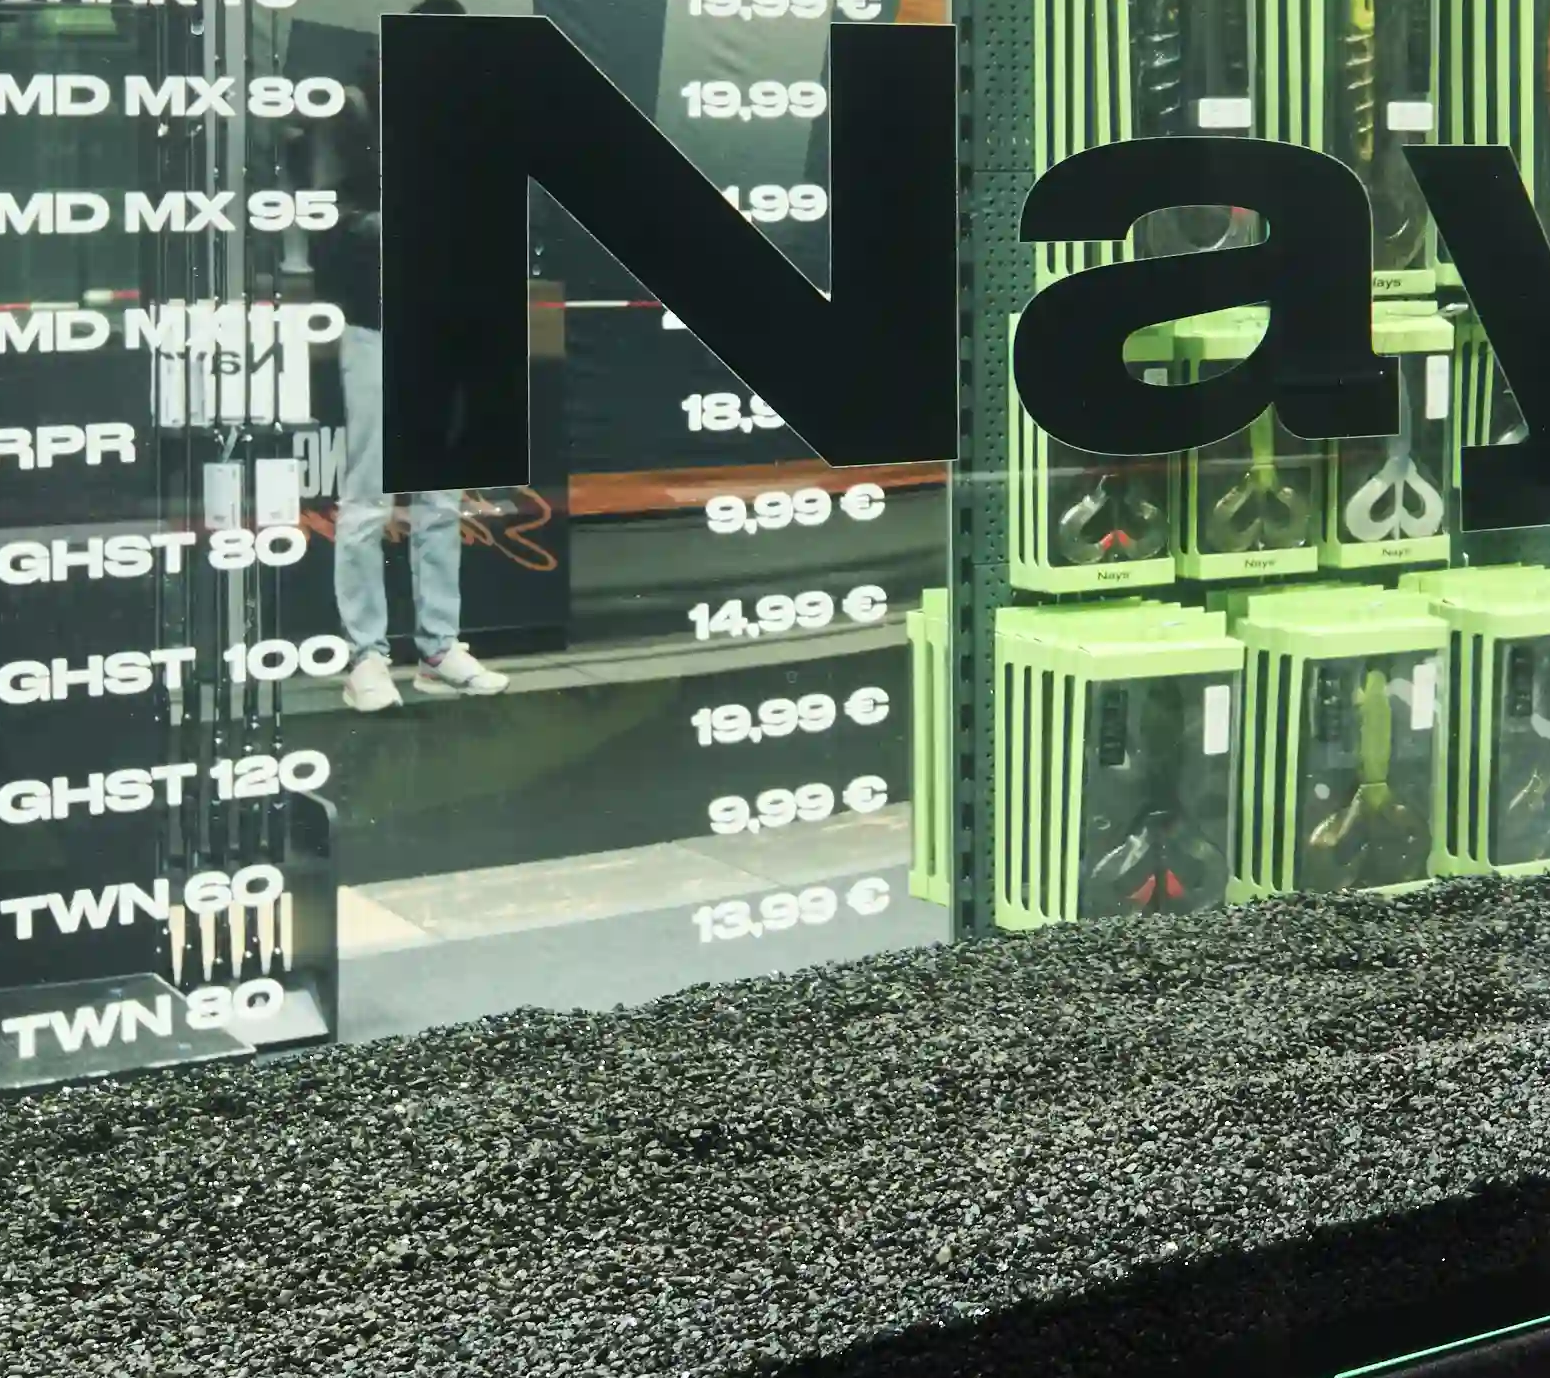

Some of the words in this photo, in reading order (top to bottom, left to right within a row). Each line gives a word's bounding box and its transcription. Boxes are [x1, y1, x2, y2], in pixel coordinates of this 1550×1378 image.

[125, 76, 237, 117] MX
[249, 77, 345, 118] 80
[681, 81, 827, 122] 19,99
[125, 192, 237, 232] MX
[249, 191, 339, 231] 95
[722, 184, 827, 222] 1,99
[682, 392, 787, 434] 18,9
[208, 526, 307, 569] 80
[705, 487, 831, 534] 9,99
[840, 483, 885, 521] €
[223, 635, 349, 682] 100
[688, 590, 834, 641] 14,99
[843, 584, 887, 621] €
[210, 749, 330, 801] 120
[691, 693, 836, 746] 19,99
[844, 686, 890, 723] €
[0, 877, 170, 940] TWN
[184, 864, 284, 914] 60
[708, 782, 834, 834] 9,99
[843, 775, 888, 812] €
[2, 994, 172, 1059] TWN
[186, 978, 284, 1030] 80
[692, 885, 837, 943] 13,99
[846, 877, 890, 915] €
